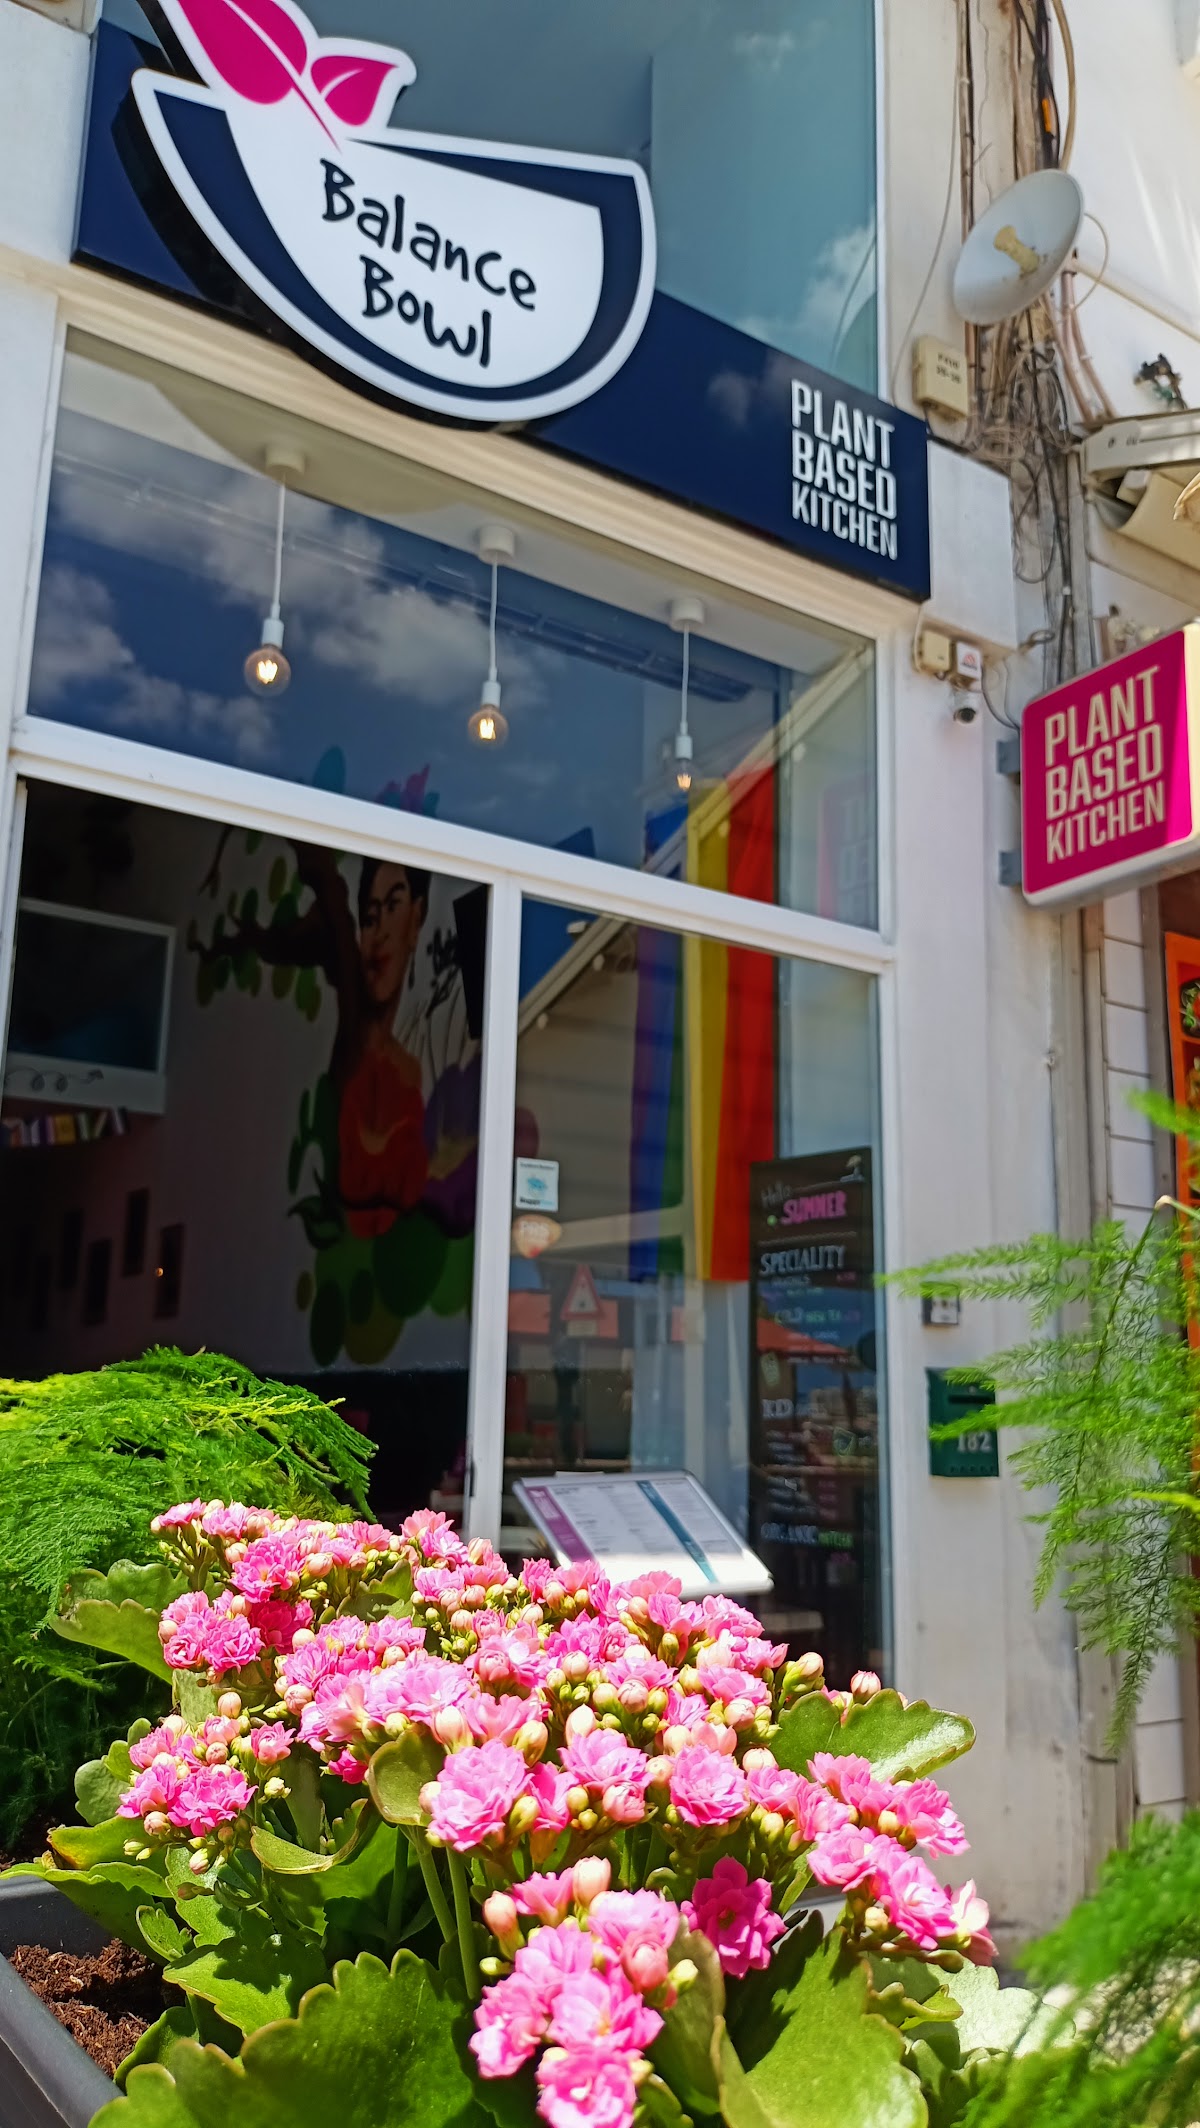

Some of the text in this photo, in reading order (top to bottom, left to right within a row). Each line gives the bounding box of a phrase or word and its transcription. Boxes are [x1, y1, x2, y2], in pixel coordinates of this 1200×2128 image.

[319, 157, 537, 312] Balance
[359, 254, 492, 369] Bowl
[791, 378, 896, 470] PLANT
[791, 428, 898, 520] BASED
[791, 479, 899, 561] KITCHEN
[1044, 664, 1160, 768] PLANT
[1045, 722, 1165, 822] BASED
[1046, 779, 1165, 865] KITCHEN
[780, 1189, 848, 1225] SUMMER
[760, 1245, 845, 1276] SPECIALITY
[957, 1430, 993, 1453] 182
